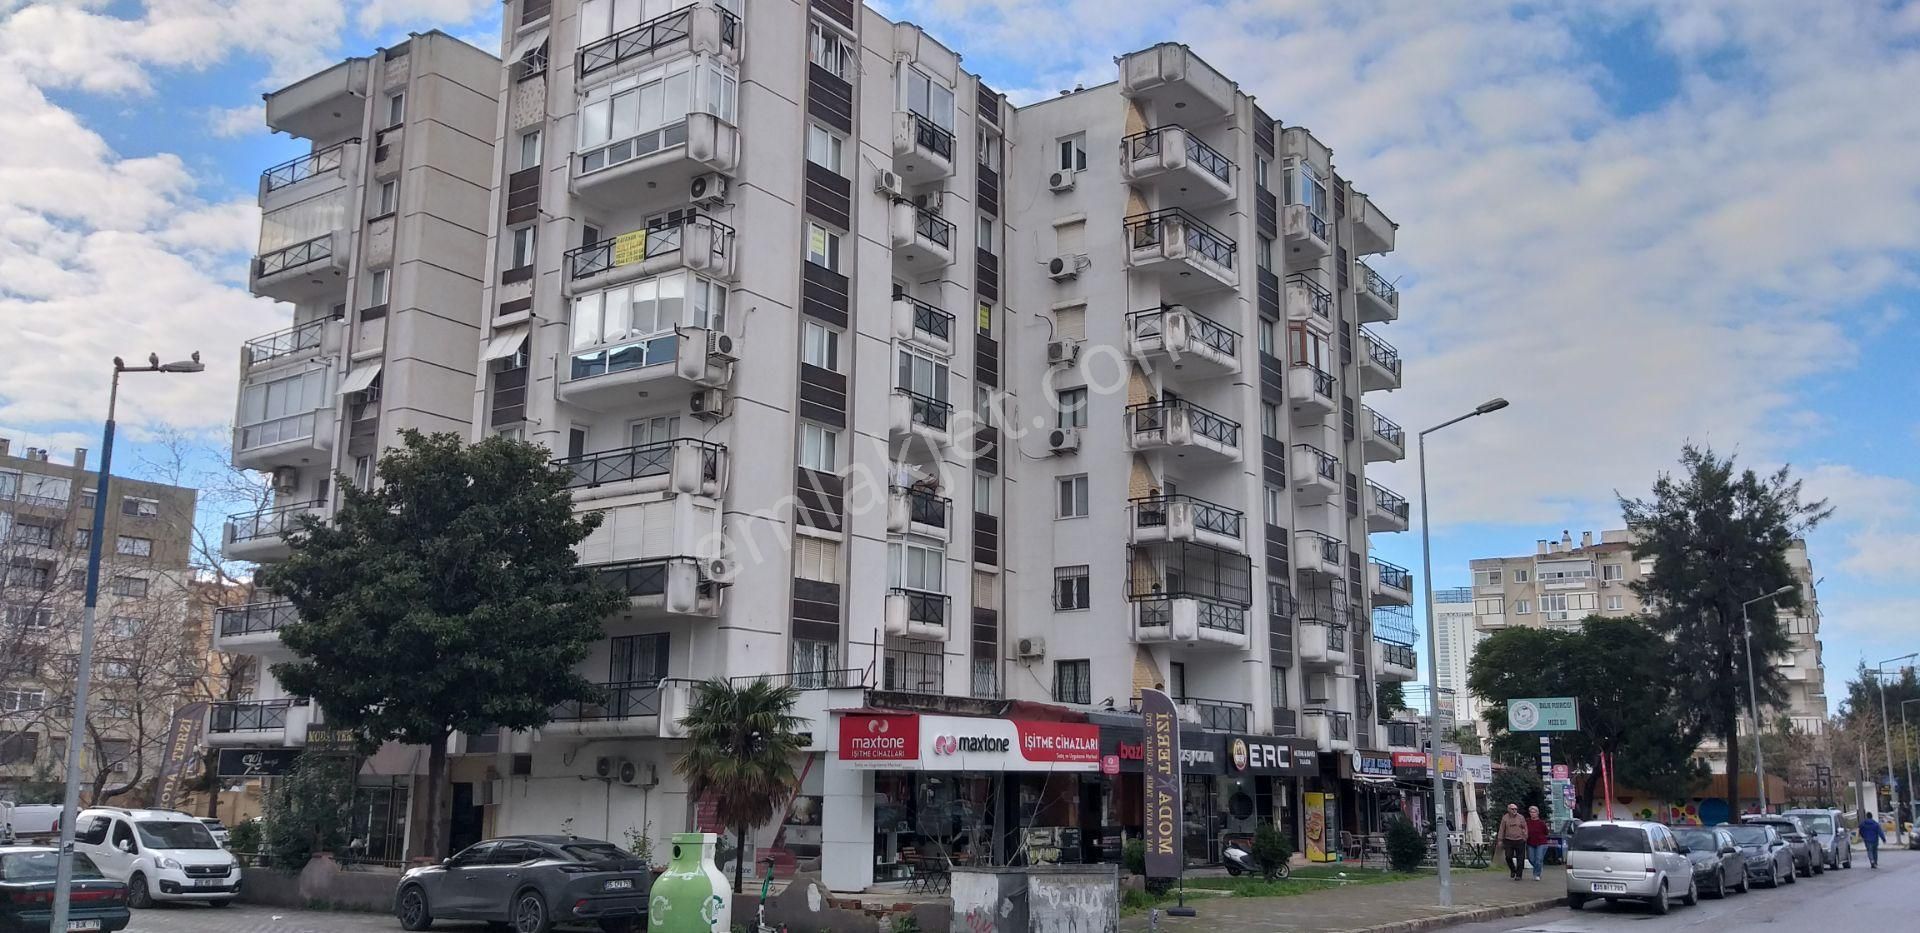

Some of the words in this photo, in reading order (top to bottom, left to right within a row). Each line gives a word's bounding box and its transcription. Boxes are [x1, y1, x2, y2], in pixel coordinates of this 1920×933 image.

[172, 718, 194, 761] TERZİ
[852, 735, 905, 749] maxtone
[958, 734, 1010, 752] maxtone
[1025, 732, 1053, 751] İŞİTME
[1056, 734, 1098, 750] CİHAZLARI
[1121, 741, 1144, 760] bazl
[1249, 743, 1290, 768] ERC
